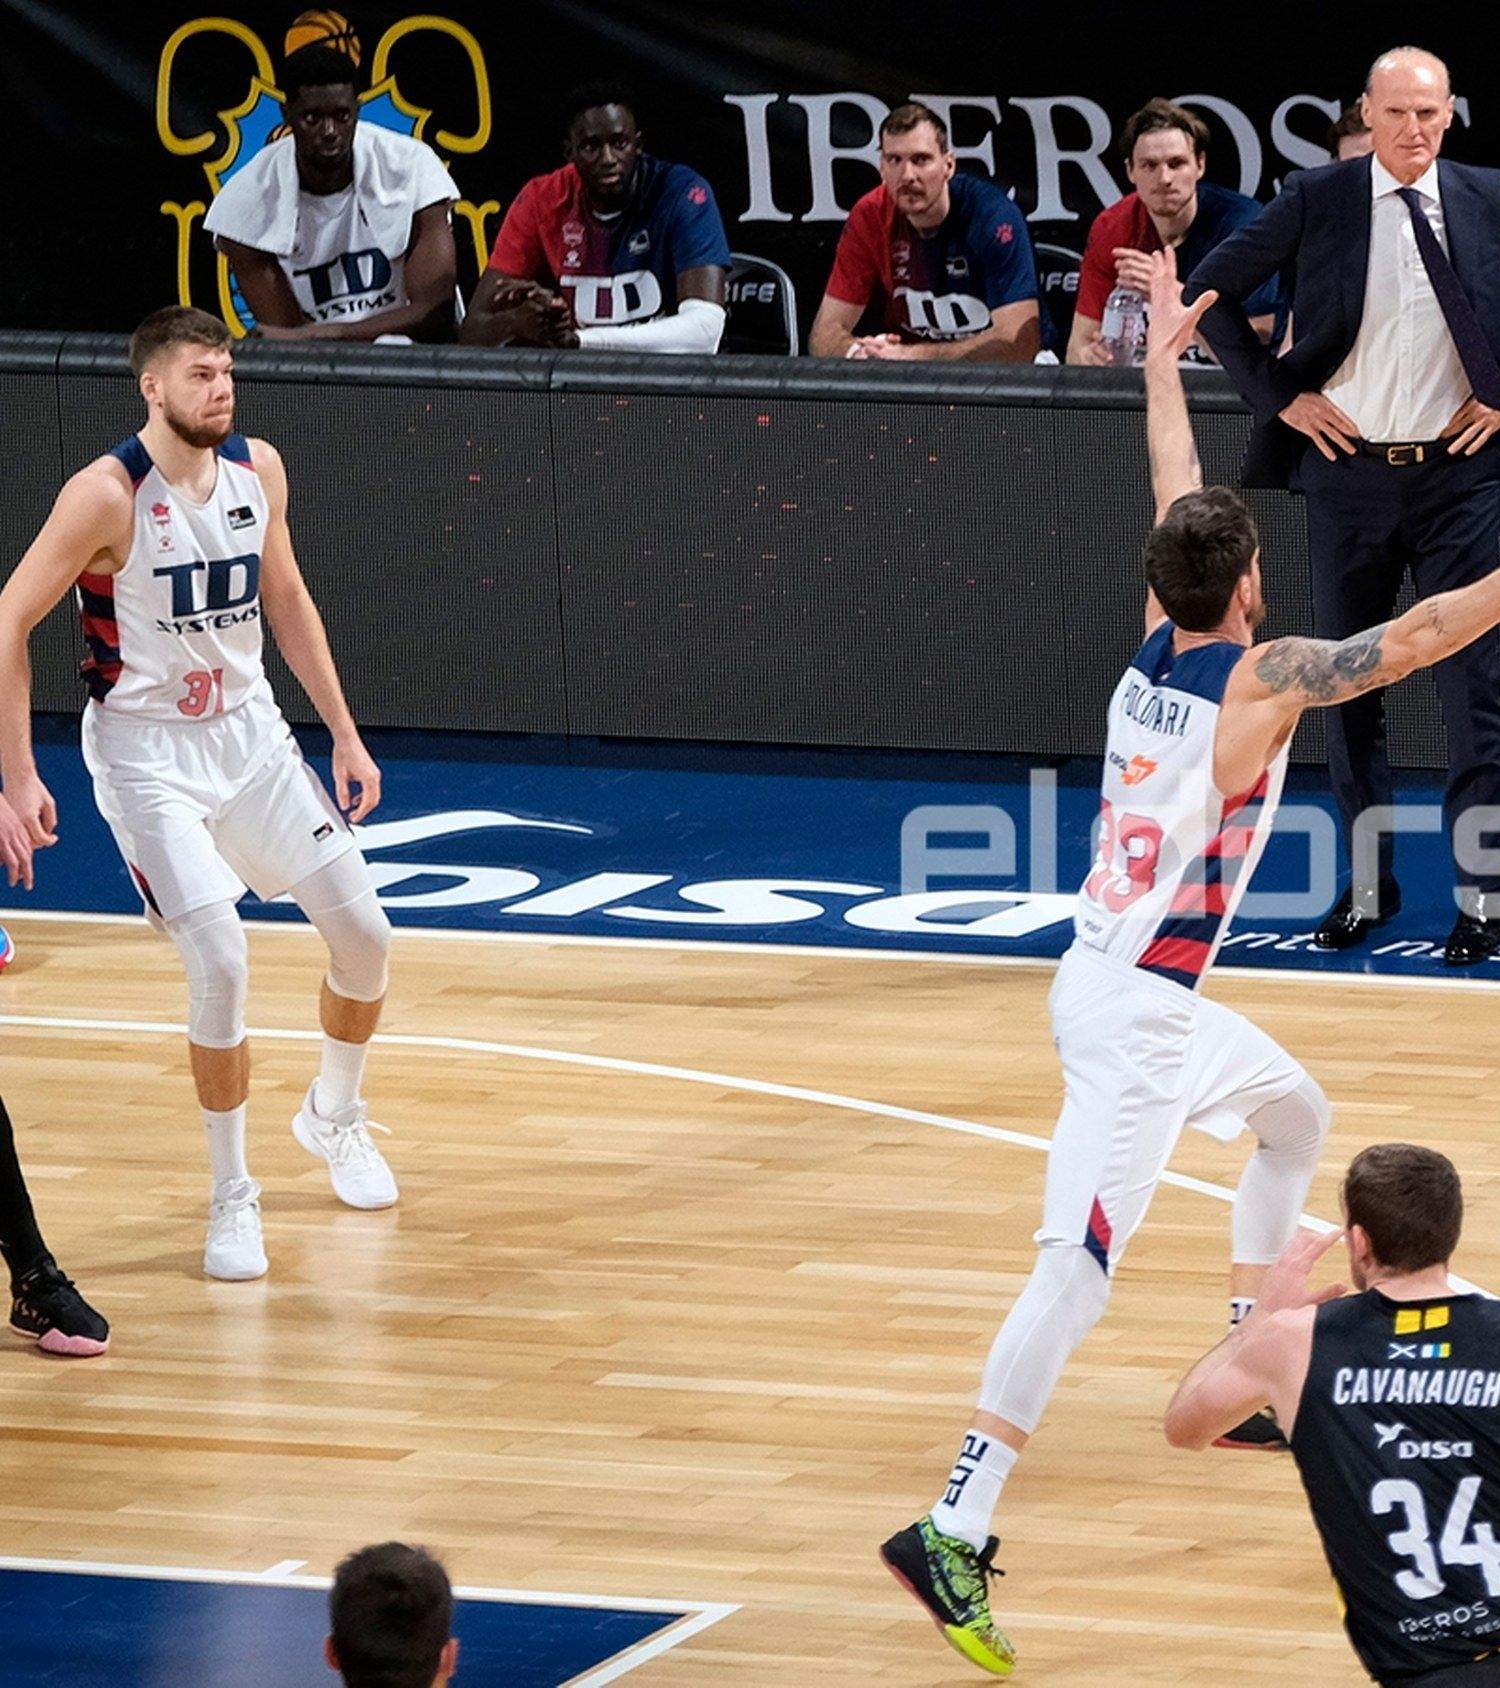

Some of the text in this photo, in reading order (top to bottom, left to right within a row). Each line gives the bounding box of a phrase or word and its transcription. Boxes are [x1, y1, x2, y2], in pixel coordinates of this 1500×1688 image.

[292, 247, 392, 306] TD
[559, 269, 662, 327] TD
[893, 286, 992, 334] TD
[152, 552, 260, 618] TD
[155, 606, 259, 636] SYSTEMS
[176, 668, 224, 718] 31
